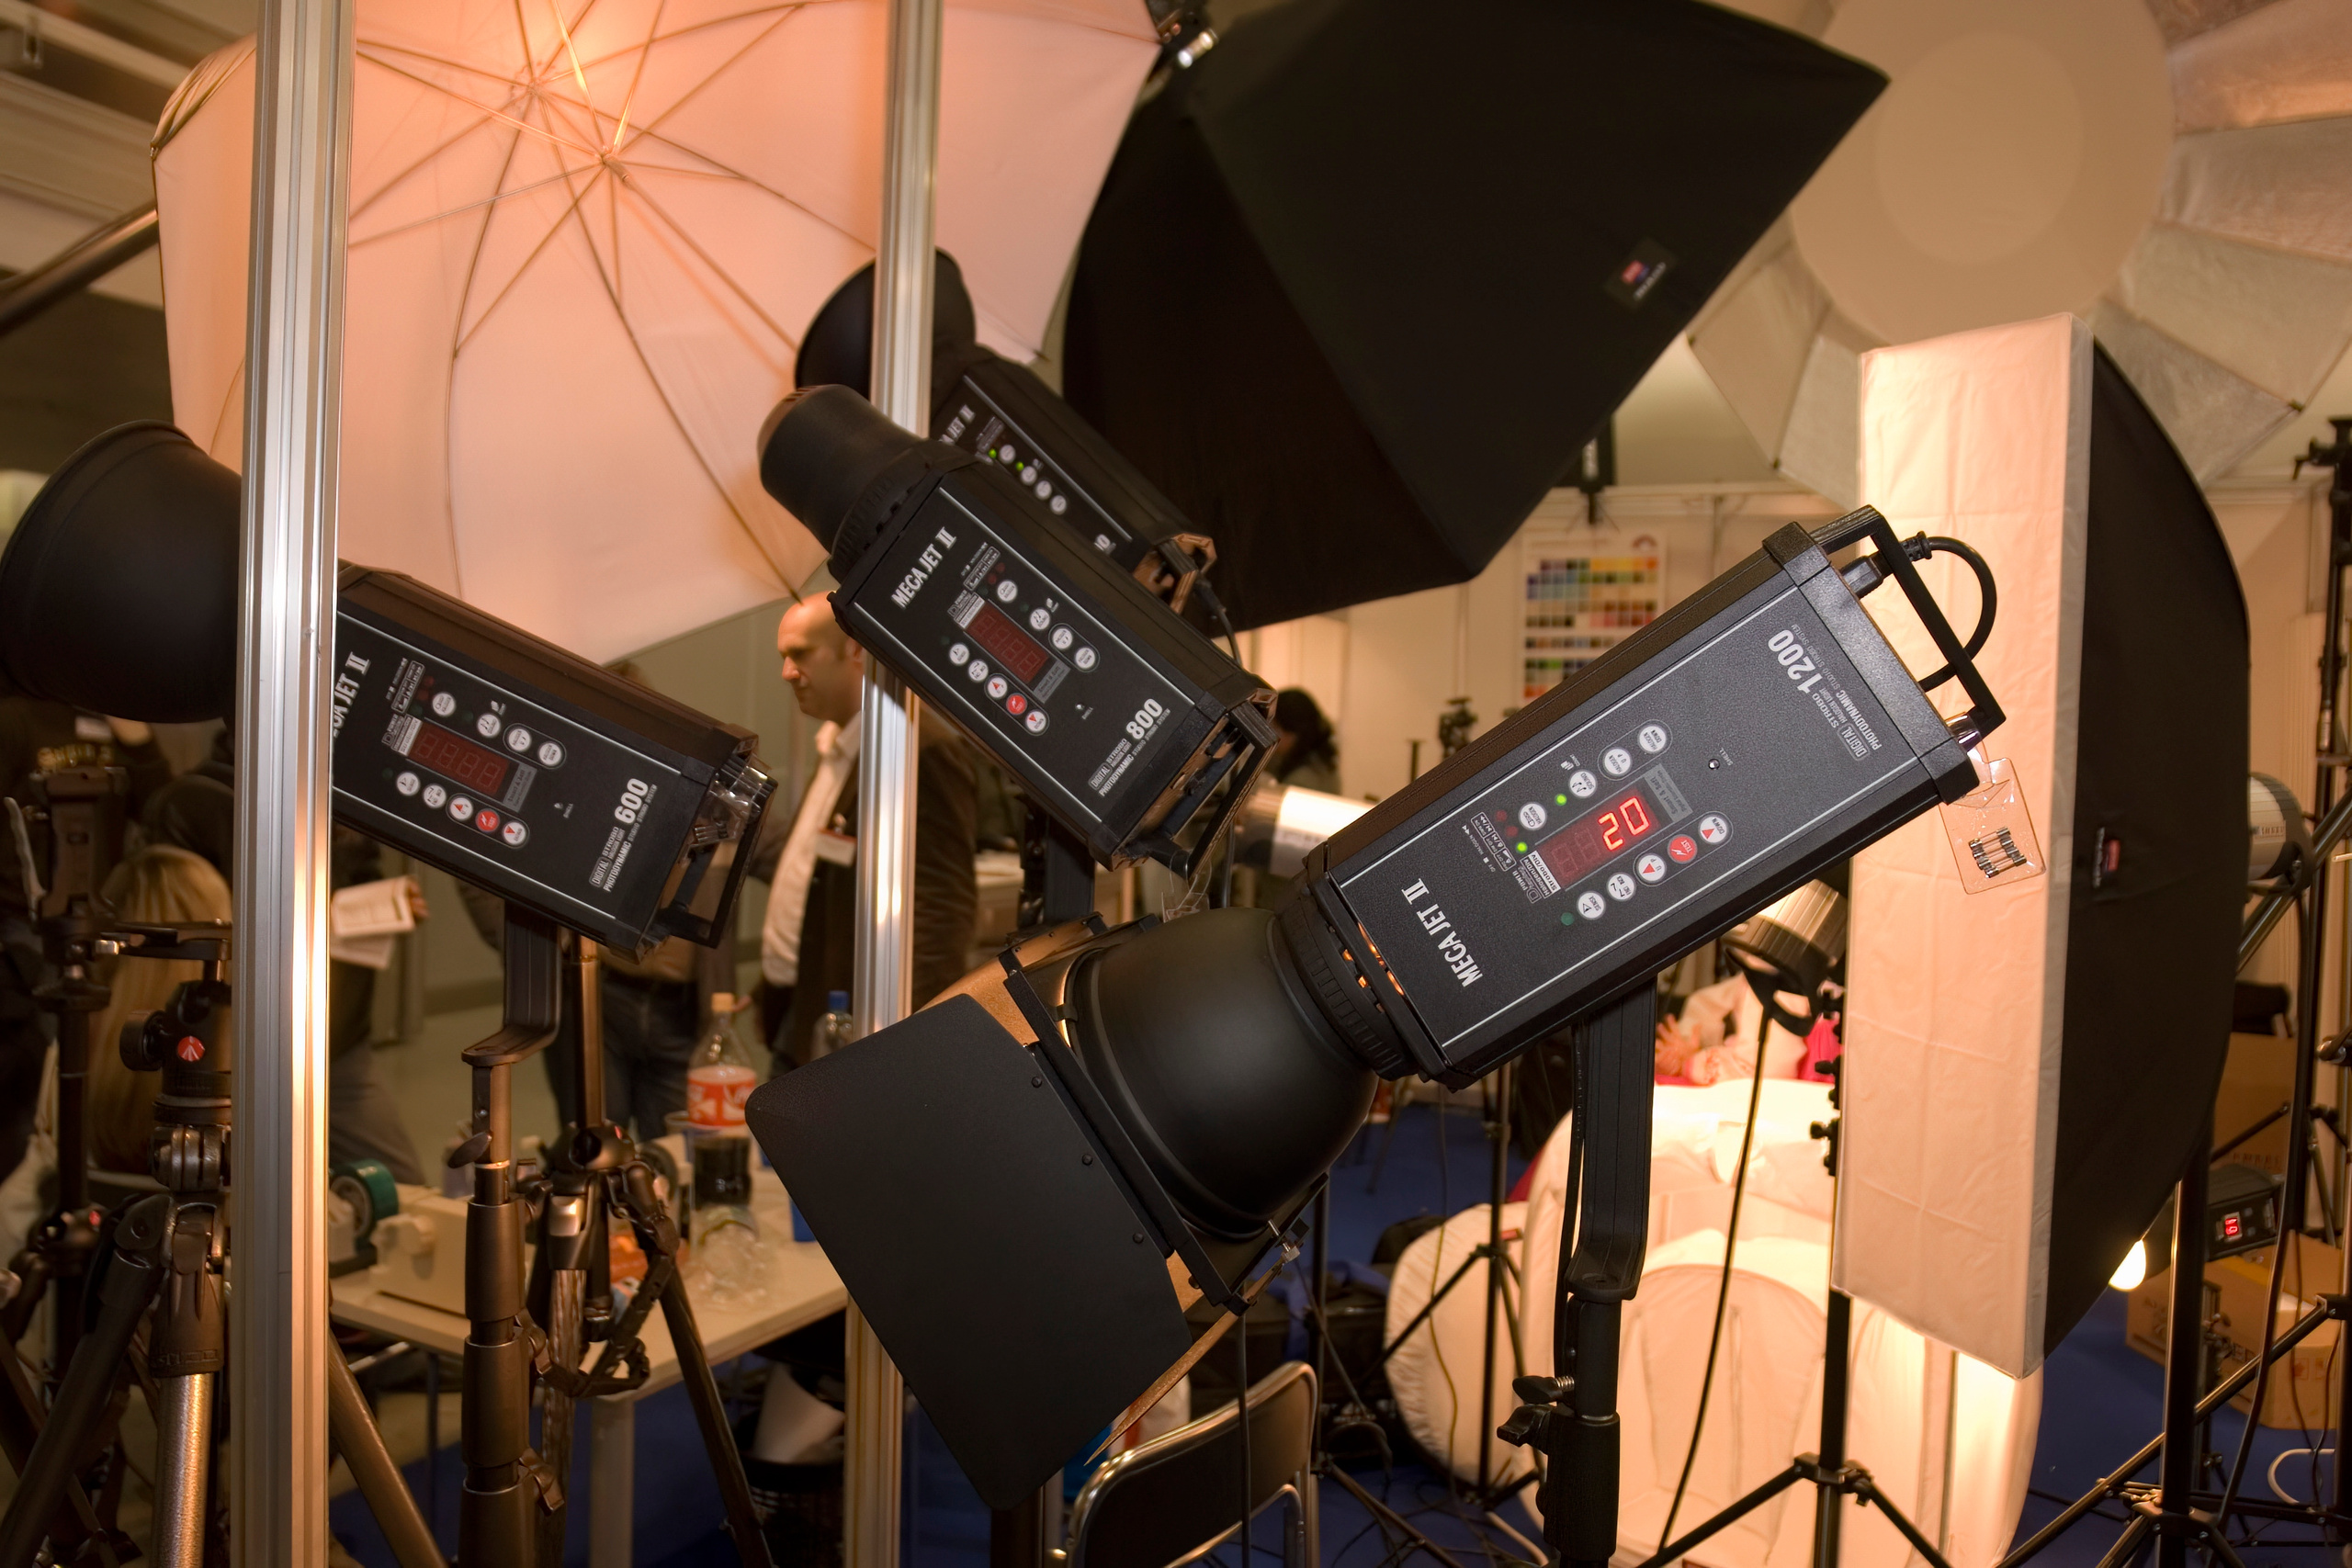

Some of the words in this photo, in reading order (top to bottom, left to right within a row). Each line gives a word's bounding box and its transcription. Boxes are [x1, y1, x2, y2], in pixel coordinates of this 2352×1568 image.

[892, 568, 928, 607] MEGA
[919, 543, 943, 573] JET
[935, 526, 956, 548] II
[1791, 623, 1810, 646] SYSTEM
[344, 651, 371, 675] II
[1768, 630, 1822, 694] 1200
[1805, 645, 1826, 669] STROBO
[334, 671, 359, 705] JET
[1821, 667, 1841, 691] STUDIO
[1819, 687, 1834, 703] LIGHT
[1811, 693, 1839, 728] STROBO
[1828, 700, 1848, 724] HALOGEN
[1836, 689, 1883, 750] PHOTODYNAMIC
[1091, 766, 1111, 788] DIGITAL
[1125, 698, 1163, 739] 800
[1643, 731, 1657, 750] HALOGEN
[1650, 728, 1662, 743] DOWN
[1841, 726, 1868, 758] DIGITAL
[1608, 754, 1623, 773] HALOGEN
[1719, 747, 1734, 767] SHELL
[1098, 753, 1135, 796] PHOTODYNAMIC
[1579, 772, 1595, 790] SOUND
[1528, 806, 1542, 825] HALOGEN
[1599, 797, 1650, 851] 20
[1711, 817, 1727, 835] DOWN
[591, 860, 609, 886] DIGITAL
[615, 778, 649, 824] 600
[1680, 840, 1692, 853] TEST
[603, 840, 631, 892] PHOTODYNAMIC
[1523, 858, 1550, 897] Halogen/Div
[1531, 853, 1557, 891] Strobo/Div
[1401, 877, 1430, 905] II
[1588, 896, 1601, 911] SENSE
[1416, 904, 1452, 936] JET
[1438, 931, 1483, 987] MEGA
